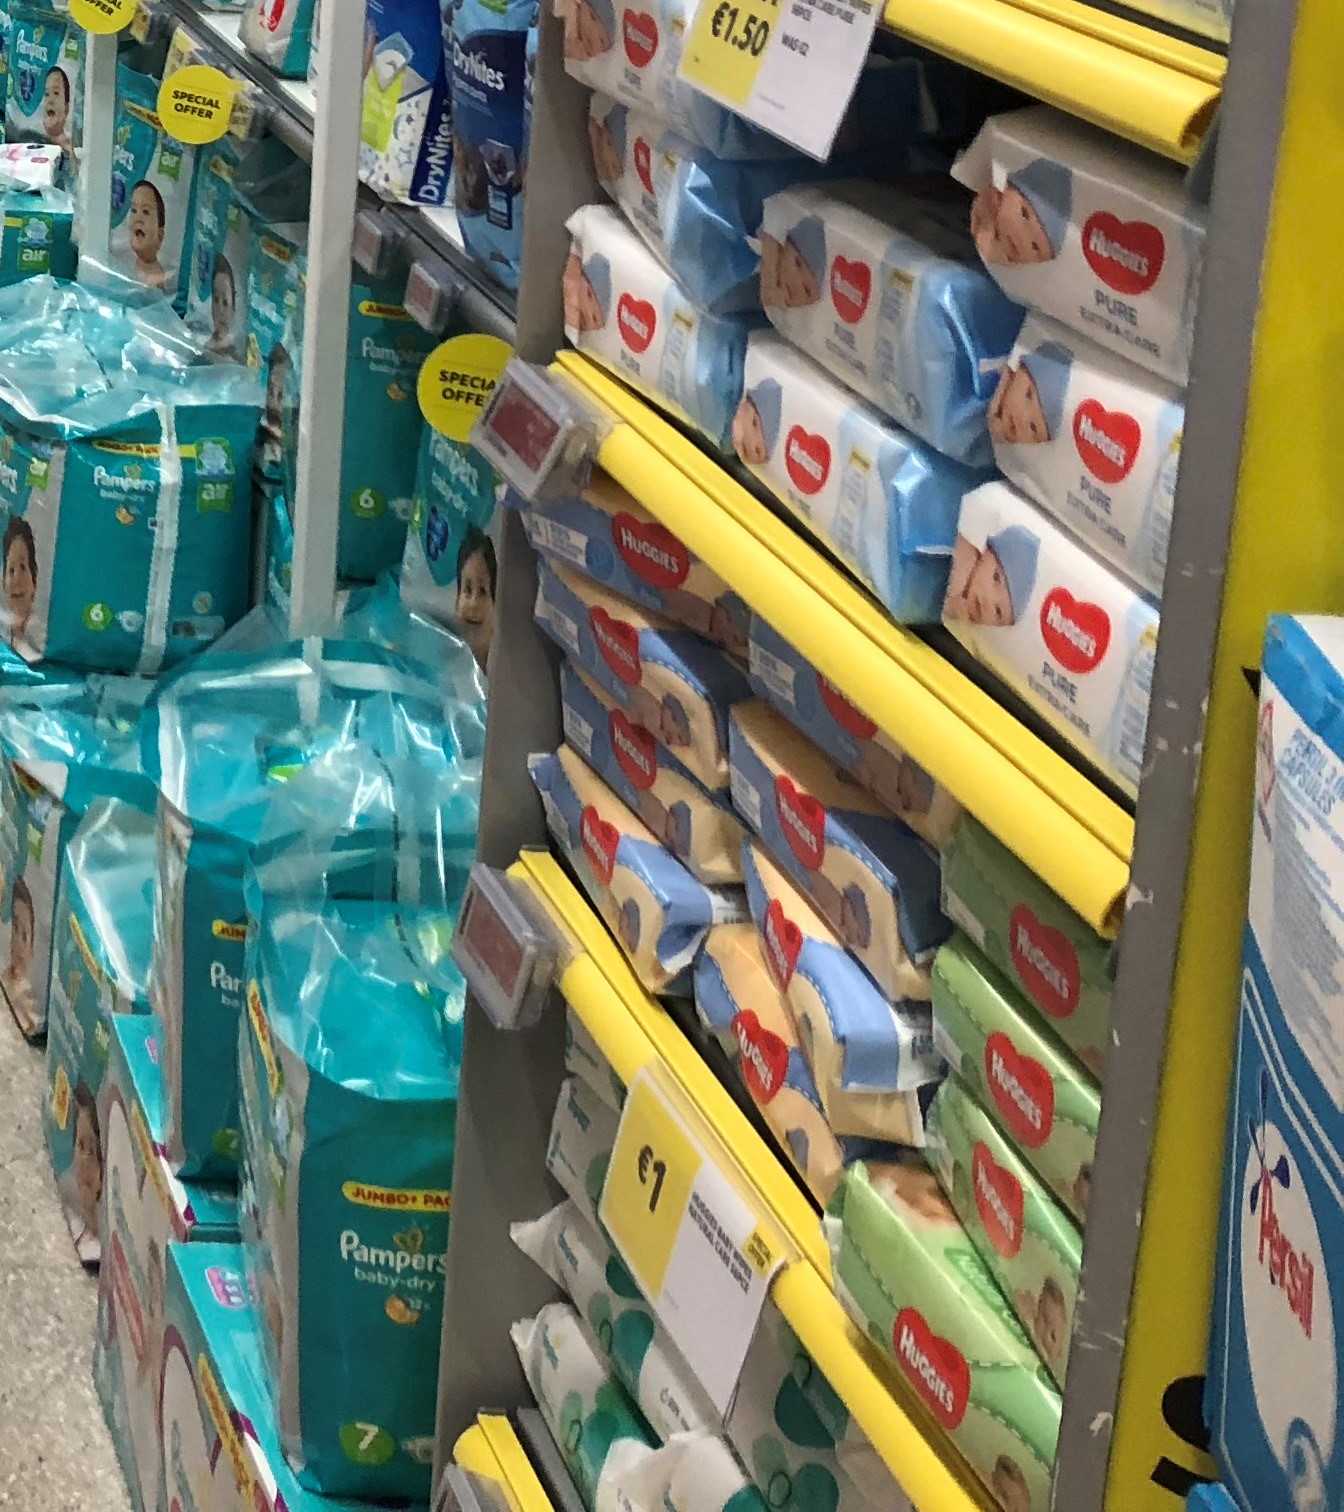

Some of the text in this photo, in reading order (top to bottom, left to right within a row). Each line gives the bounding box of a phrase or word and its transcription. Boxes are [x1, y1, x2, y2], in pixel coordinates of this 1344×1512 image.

[712, 1, 770, 56] €1.50
[172, 89, 222, 112] SPECIAL
[173, 101, 214, 120] OFFER
[21, 249, 46, 263] air
[1087, 231, 1152, 277] HUGGIES
[1094, 293, 1138, 326] PURE
[439, 370, 496, 391] SPECIA
[442, 389, 484, 406] OFFE
[1078, 424, 1130, 465] HUGGIES
[93, 467, 155, 492] Pampers
[200, 485, 228, 502] air
[1079, 477, 1112, 512] PURE
[361, 491, 376, 511] 6
[620, 528, 683, 572] HUGGIES
[91, 604, 105, 623] 6
[1045, 611, 1099, 655] HUGGIES
[1042, 664, 1079, 701] PURE
[1015, 930, 1072, 998] HUGGIES
[991, 1057, 1044, 1132] HUGGIES
[637, 1144, 667, 1213] €1
[975, 1167, 1018, 1237] HUGGIES
[340, 1229, 448, 1274] Pampers
[1259, 1193, 1315, 1339] Persil
[354, 1266, 436, 1293] baby-dry
[899, 1335, 956, 1416] HUGGIES
[356, 1422, 379, 1451] 7
